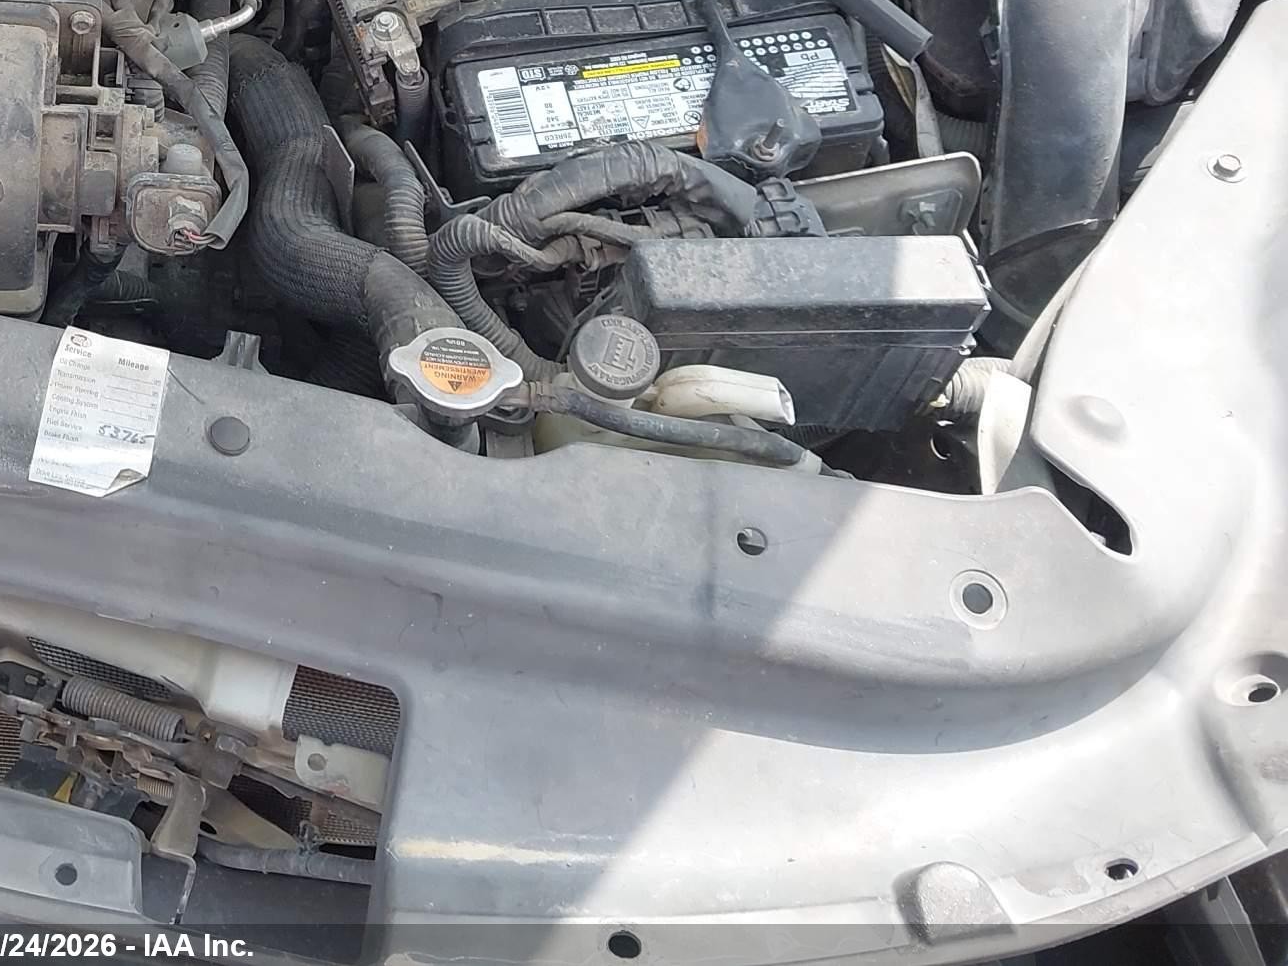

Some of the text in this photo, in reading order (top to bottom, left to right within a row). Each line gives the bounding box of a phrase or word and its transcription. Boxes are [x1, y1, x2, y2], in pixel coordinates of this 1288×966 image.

[521, 68, 542, 79] STD
[64, 344, 92, 357] Service
[68, 359, 91, 370] Change
[117, 357, 150, 371] Mileage
[56, 369, 96, 383] Transmission
[433, 370, 476, 382] WARNING
[98, 425, 155, 445] 53765
